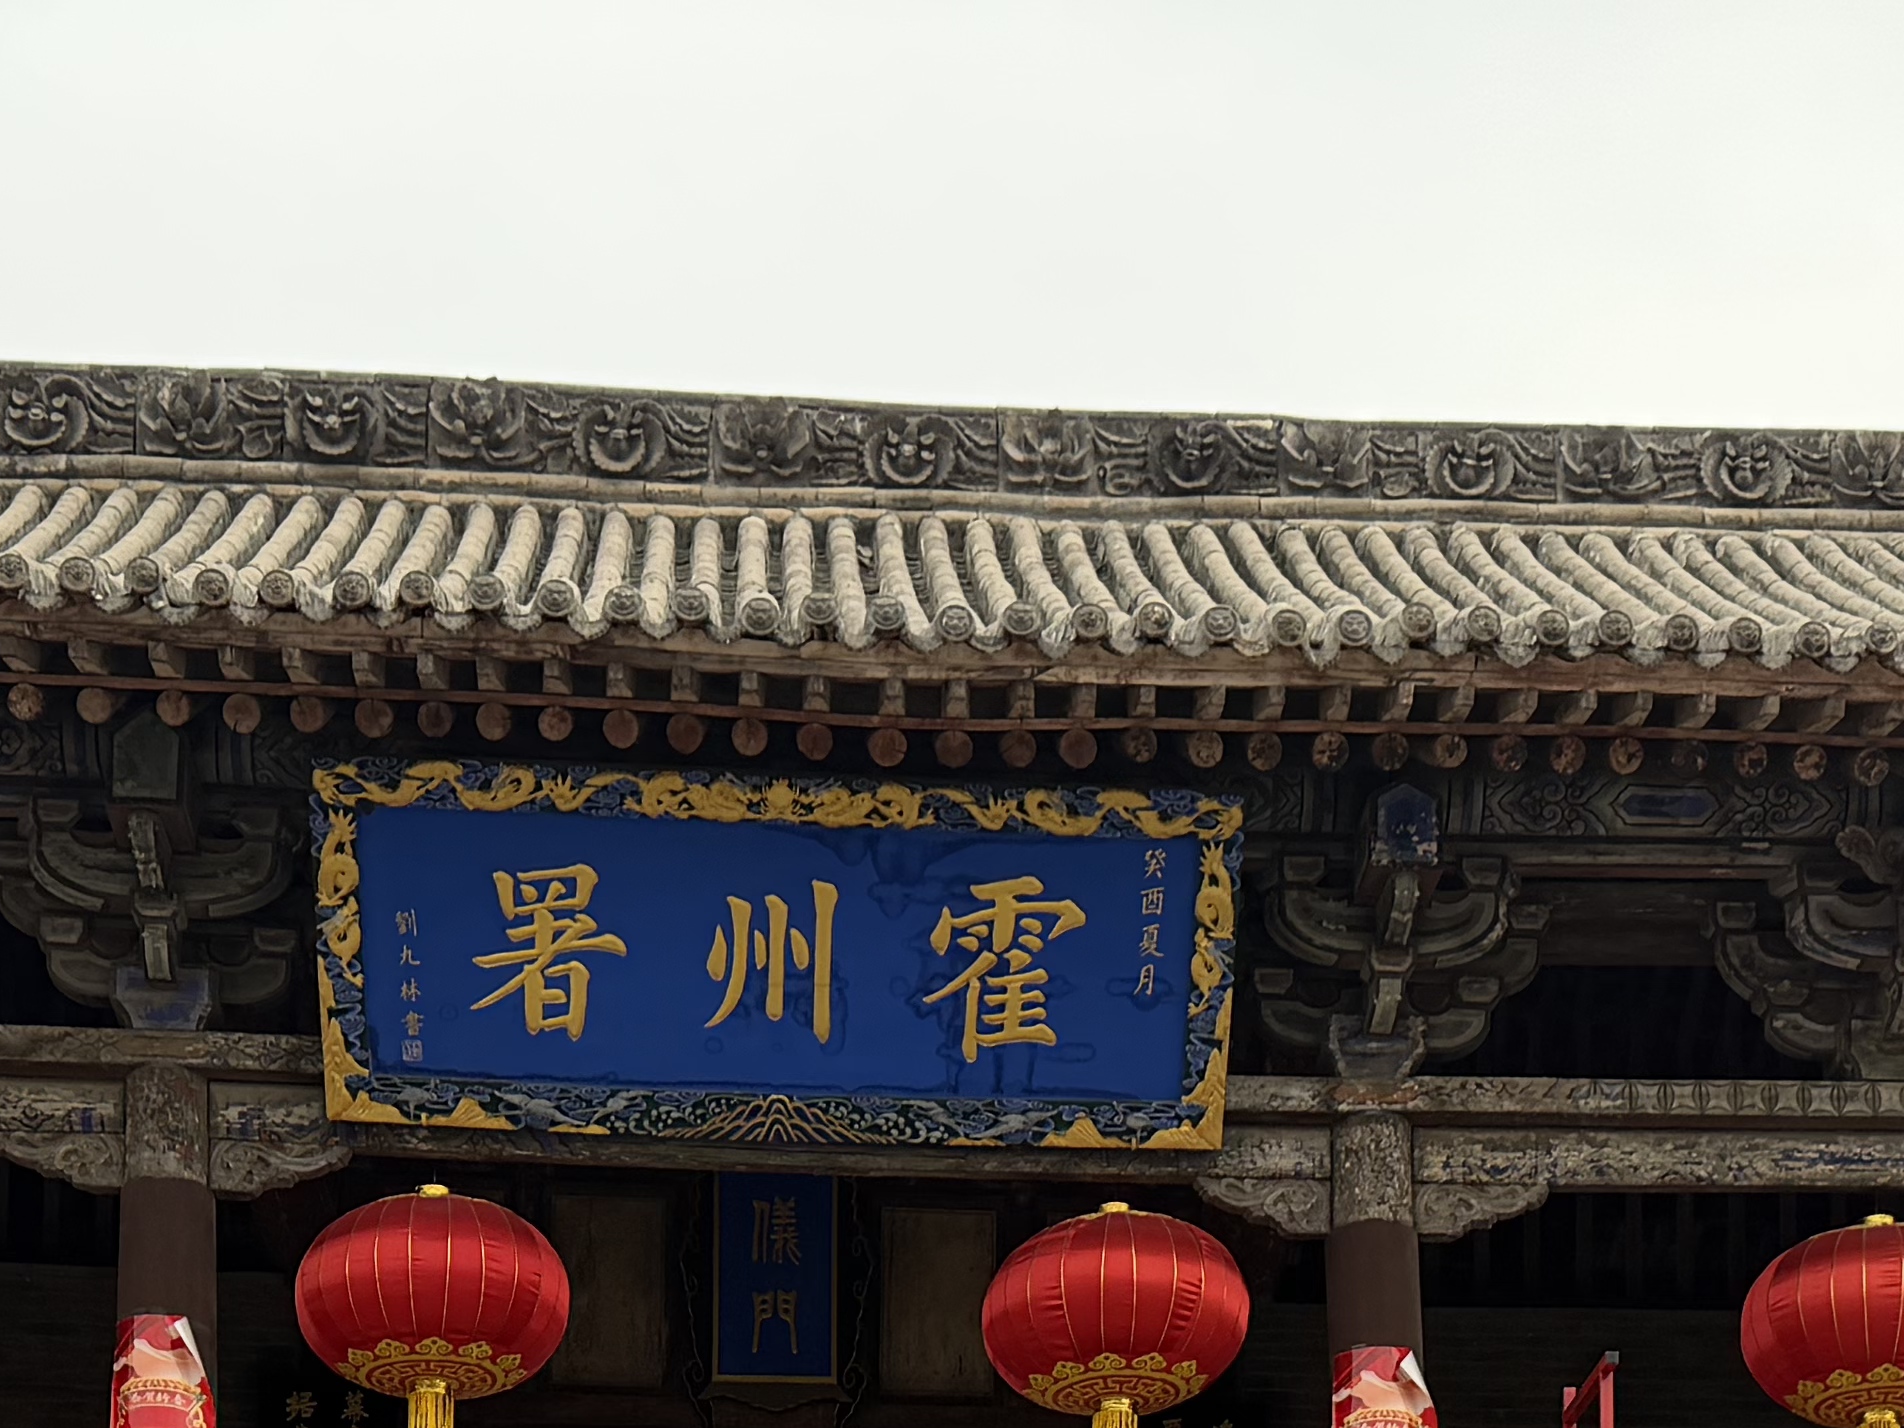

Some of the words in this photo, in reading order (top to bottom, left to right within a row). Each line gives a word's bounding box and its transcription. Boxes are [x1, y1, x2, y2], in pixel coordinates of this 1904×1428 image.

[470, 862, 1086, 1064] 霍州署
[1133, 848, 1167, 995] 癸酉夏月
